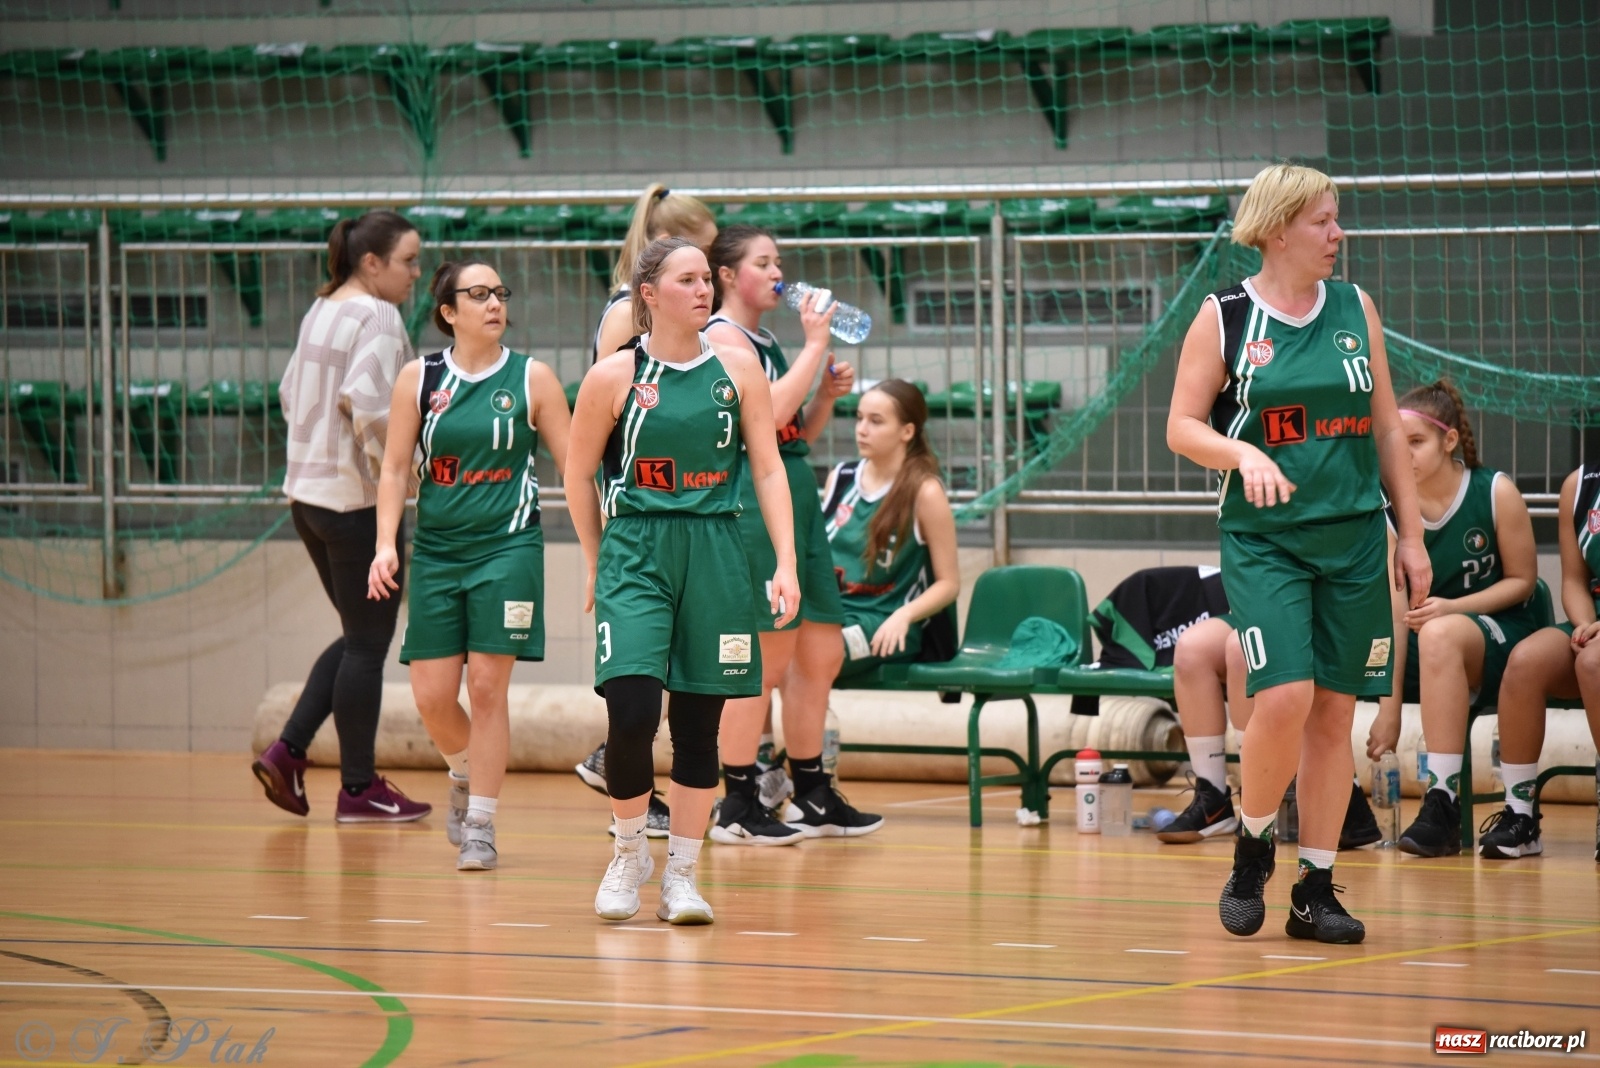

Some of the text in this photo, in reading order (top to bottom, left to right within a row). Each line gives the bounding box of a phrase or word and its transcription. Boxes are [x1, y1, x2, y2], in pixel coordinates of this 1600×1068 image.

[1220, 292, 1246, 303] COLO
[1342, 356, 1373, 393] 10
[492, 416, 514, 450] 11
[716, 411, 733, 449] 3
[1266, 410, 1303, 442] K
[637, 462, 672, 488] K
[598, 621, 612, 665] 3
